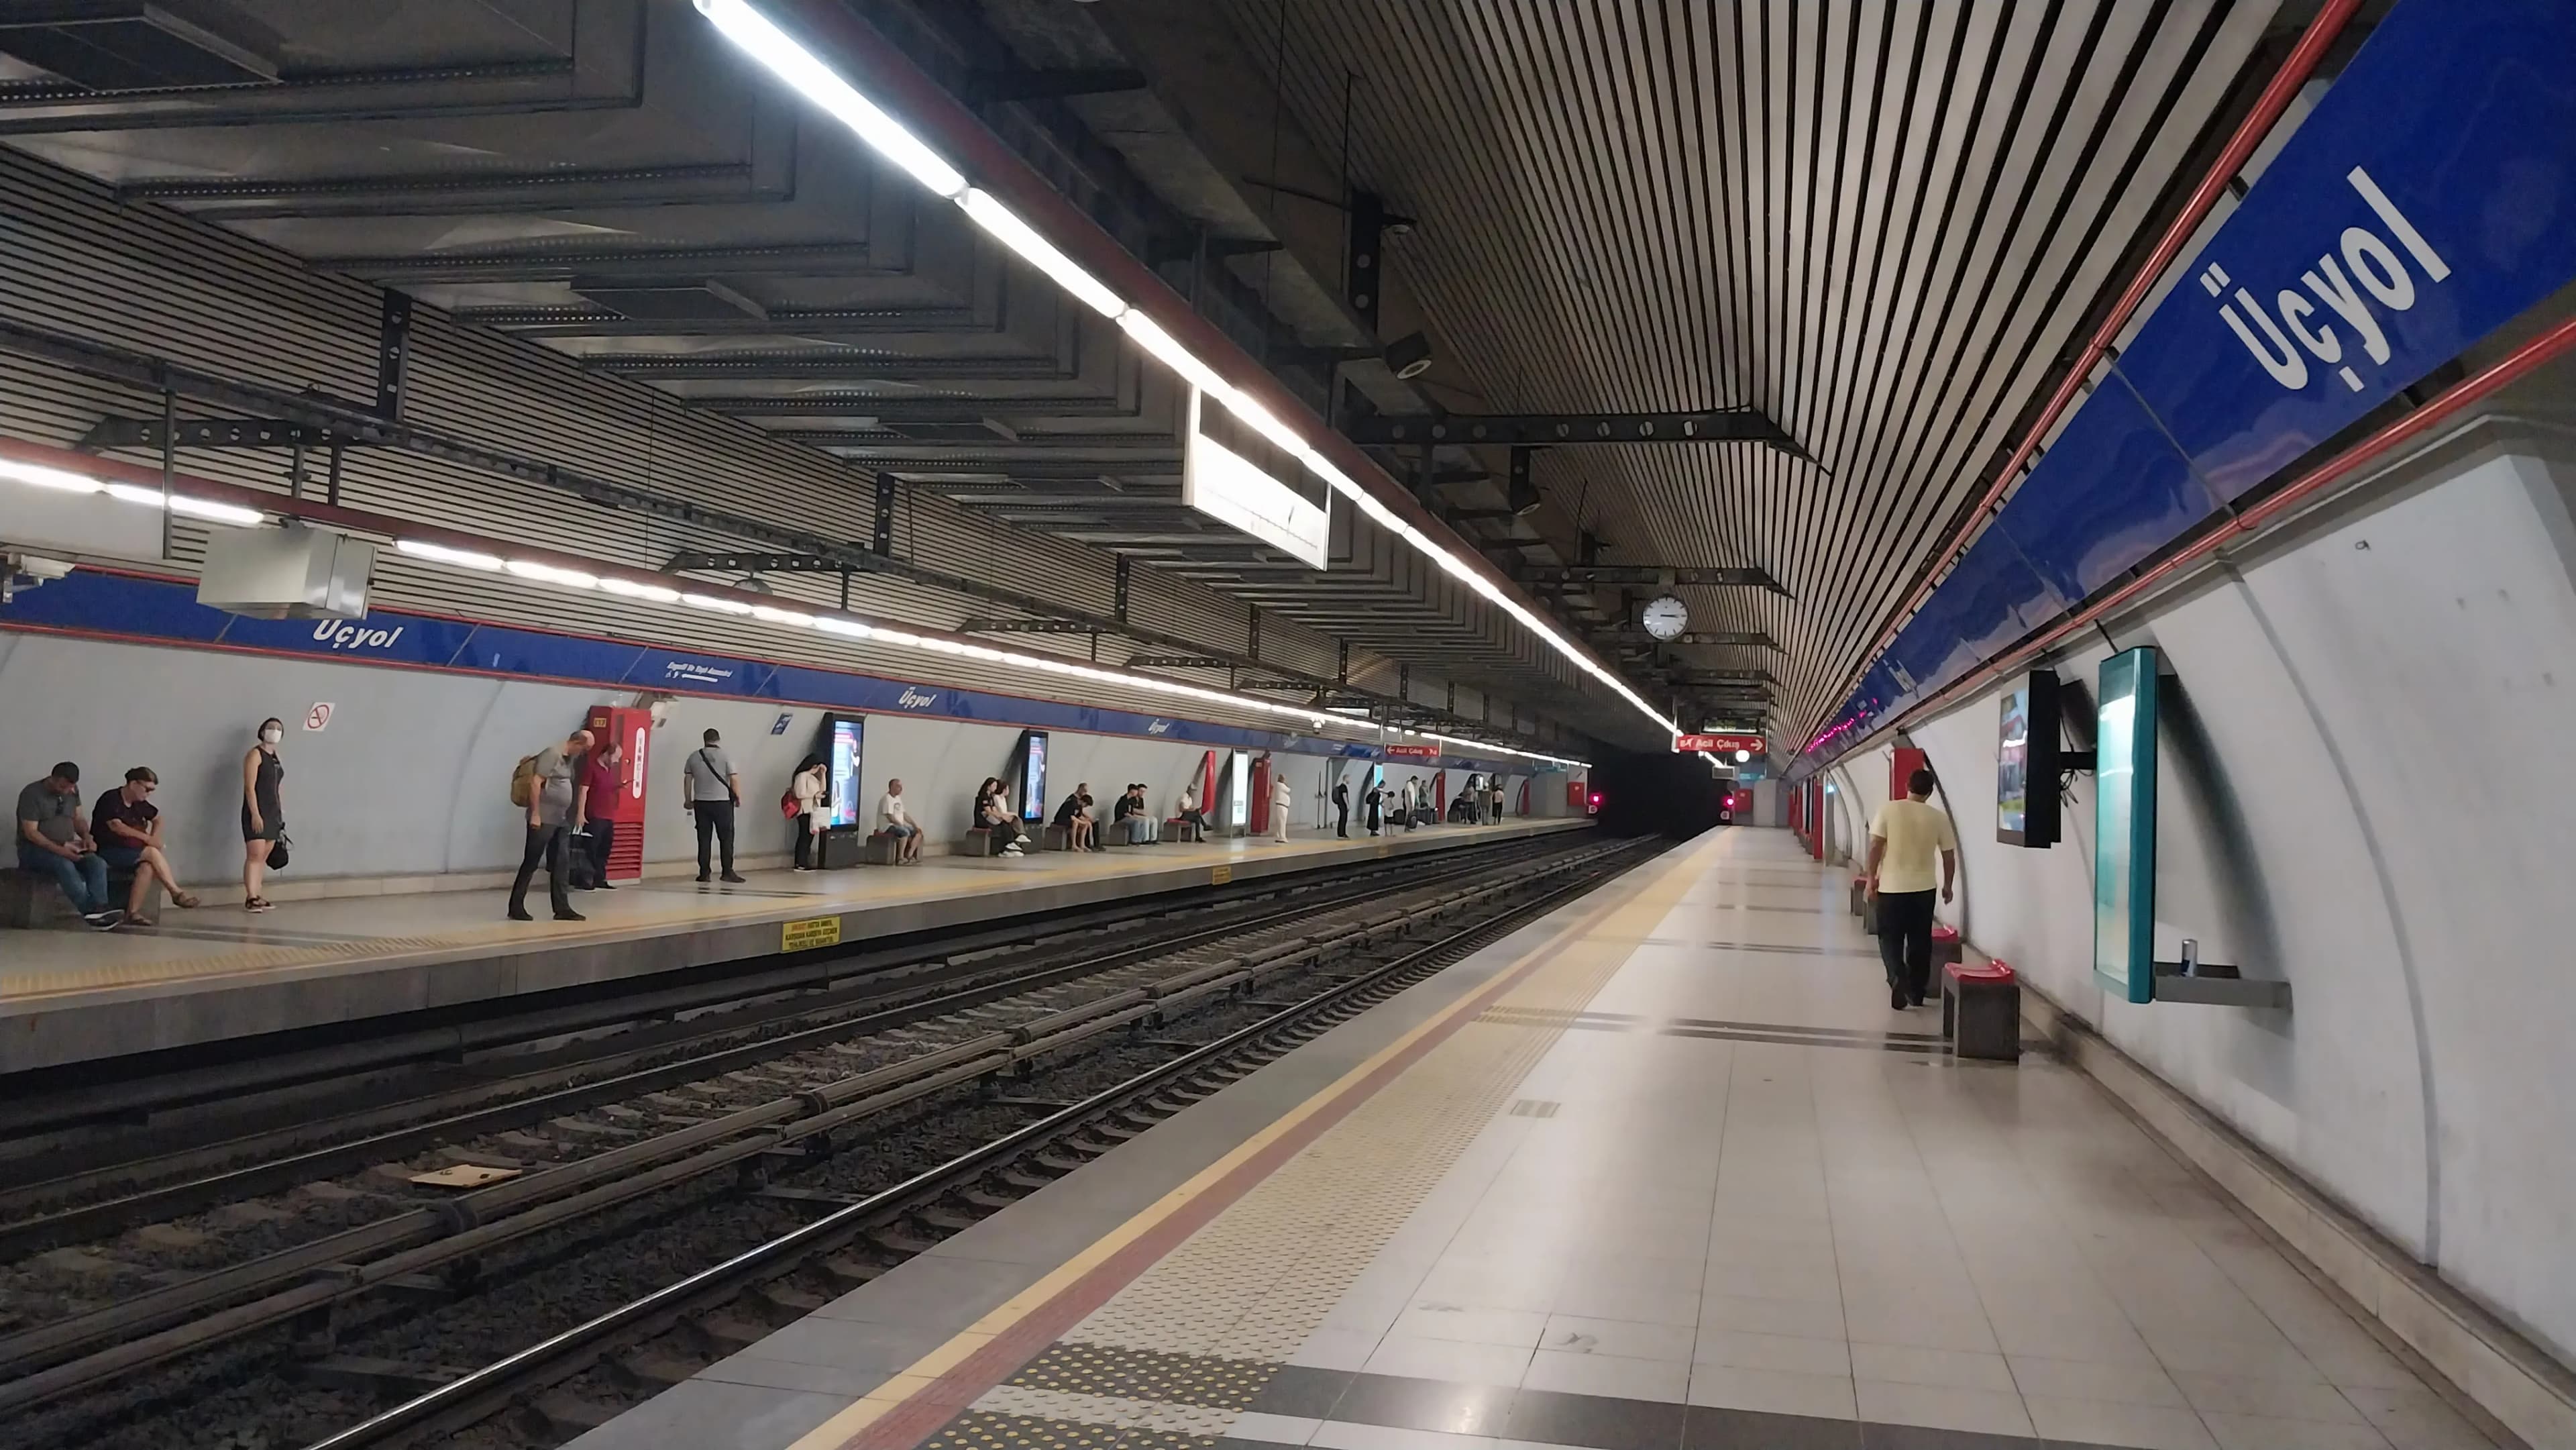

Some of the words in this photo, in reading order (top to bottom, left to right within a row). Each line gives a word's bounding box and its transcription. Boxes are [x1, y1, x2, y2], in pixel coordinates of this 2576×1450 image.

[2200, 165, 2452, 393] Üçyol
[898, 686, 937, 709] Üçyol
[1696, 739, 1713, 747] Acil
